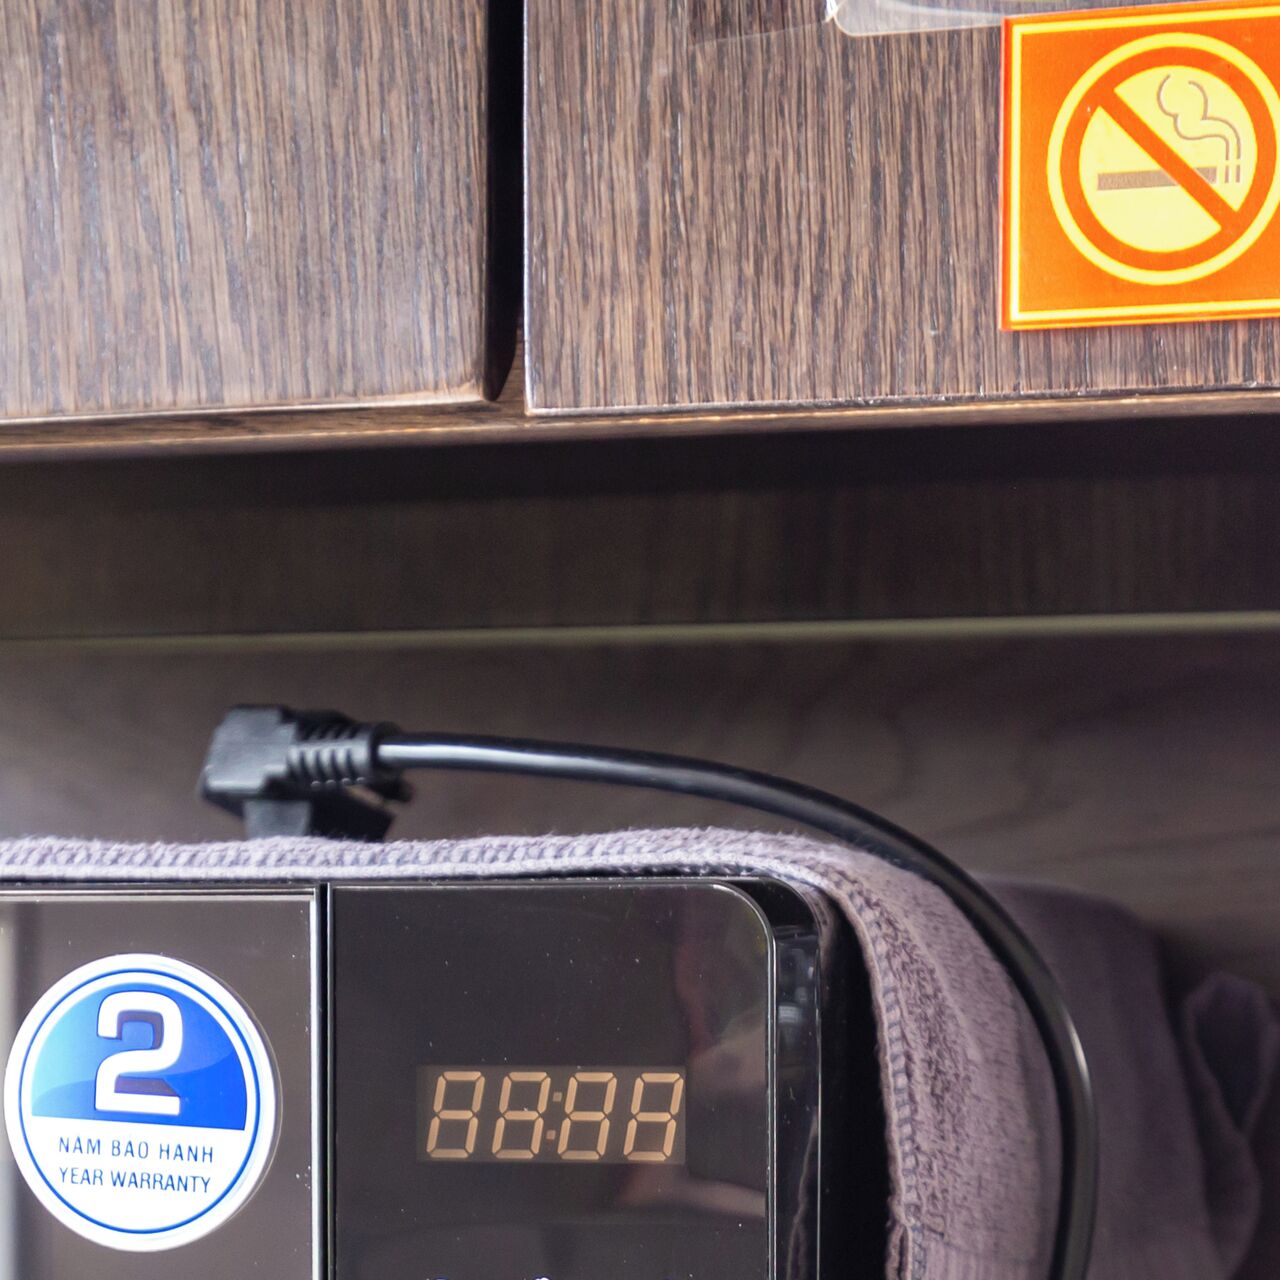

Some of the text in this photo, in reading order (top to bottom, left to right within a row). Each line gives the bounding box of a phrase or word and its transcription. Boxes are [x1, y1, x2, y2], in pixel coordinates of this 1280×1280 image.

[95, 990, 184, 1116] 2
[59, 1167, 211, 1194] YEAR WARRANTY
